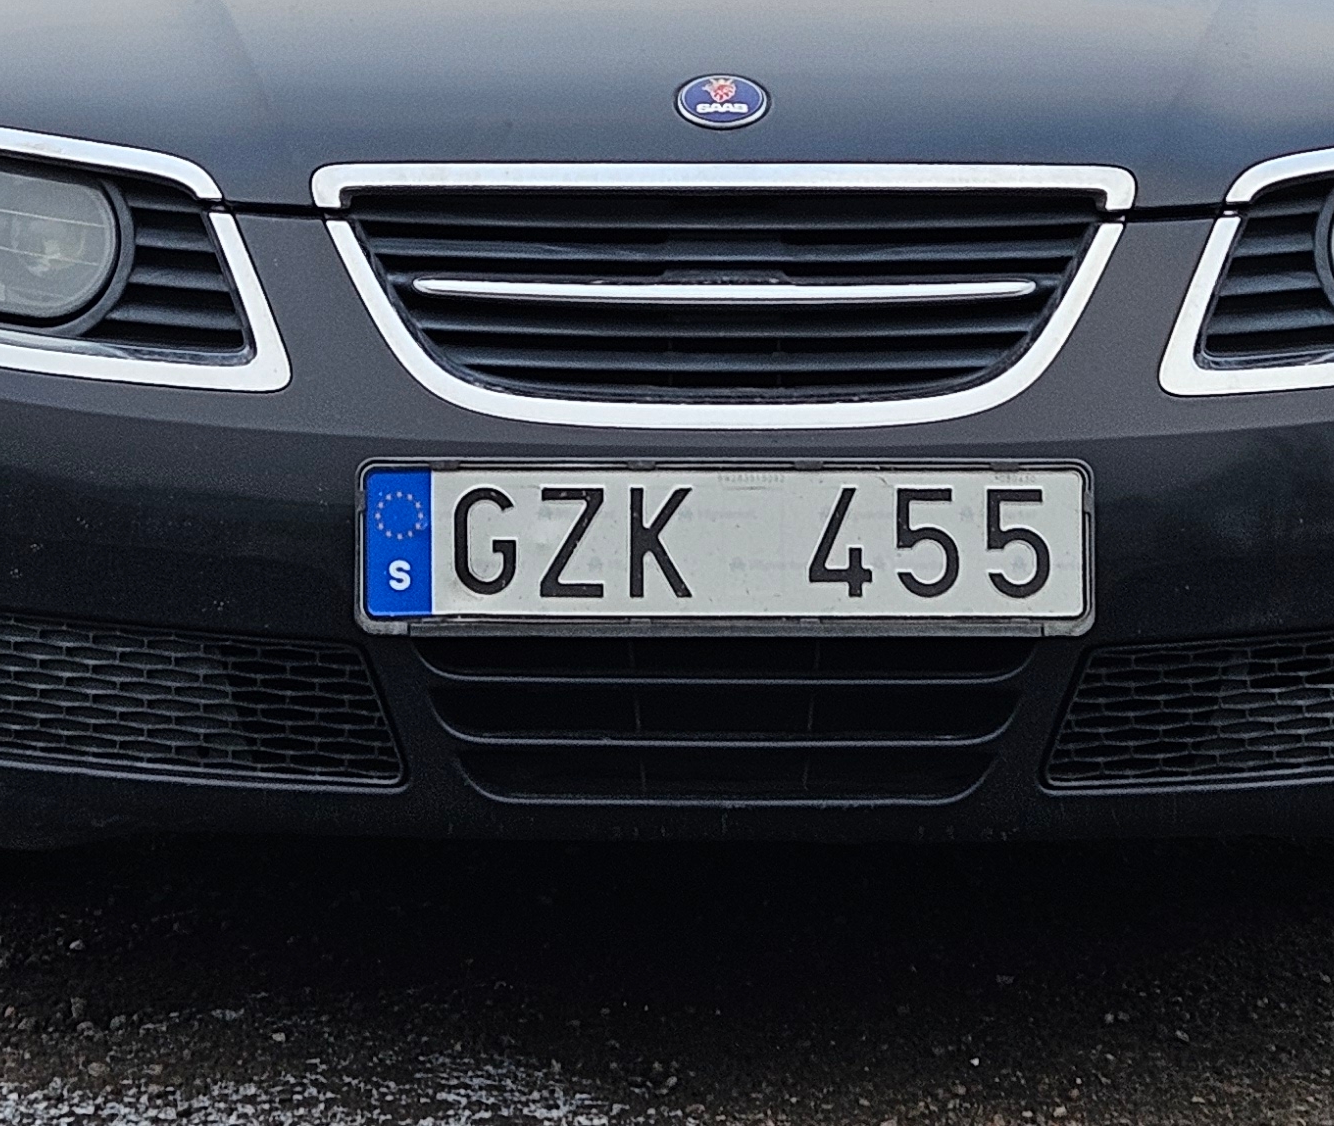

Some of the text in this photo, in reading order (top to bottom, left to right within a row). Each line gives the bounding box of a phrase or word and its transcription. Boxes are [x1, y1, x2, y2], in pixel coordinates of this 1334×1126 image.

[696, 103, 749, 113] SAAB
[452, 486, 1052, 600] GZK 455
[388, 560, 411, 592] S
